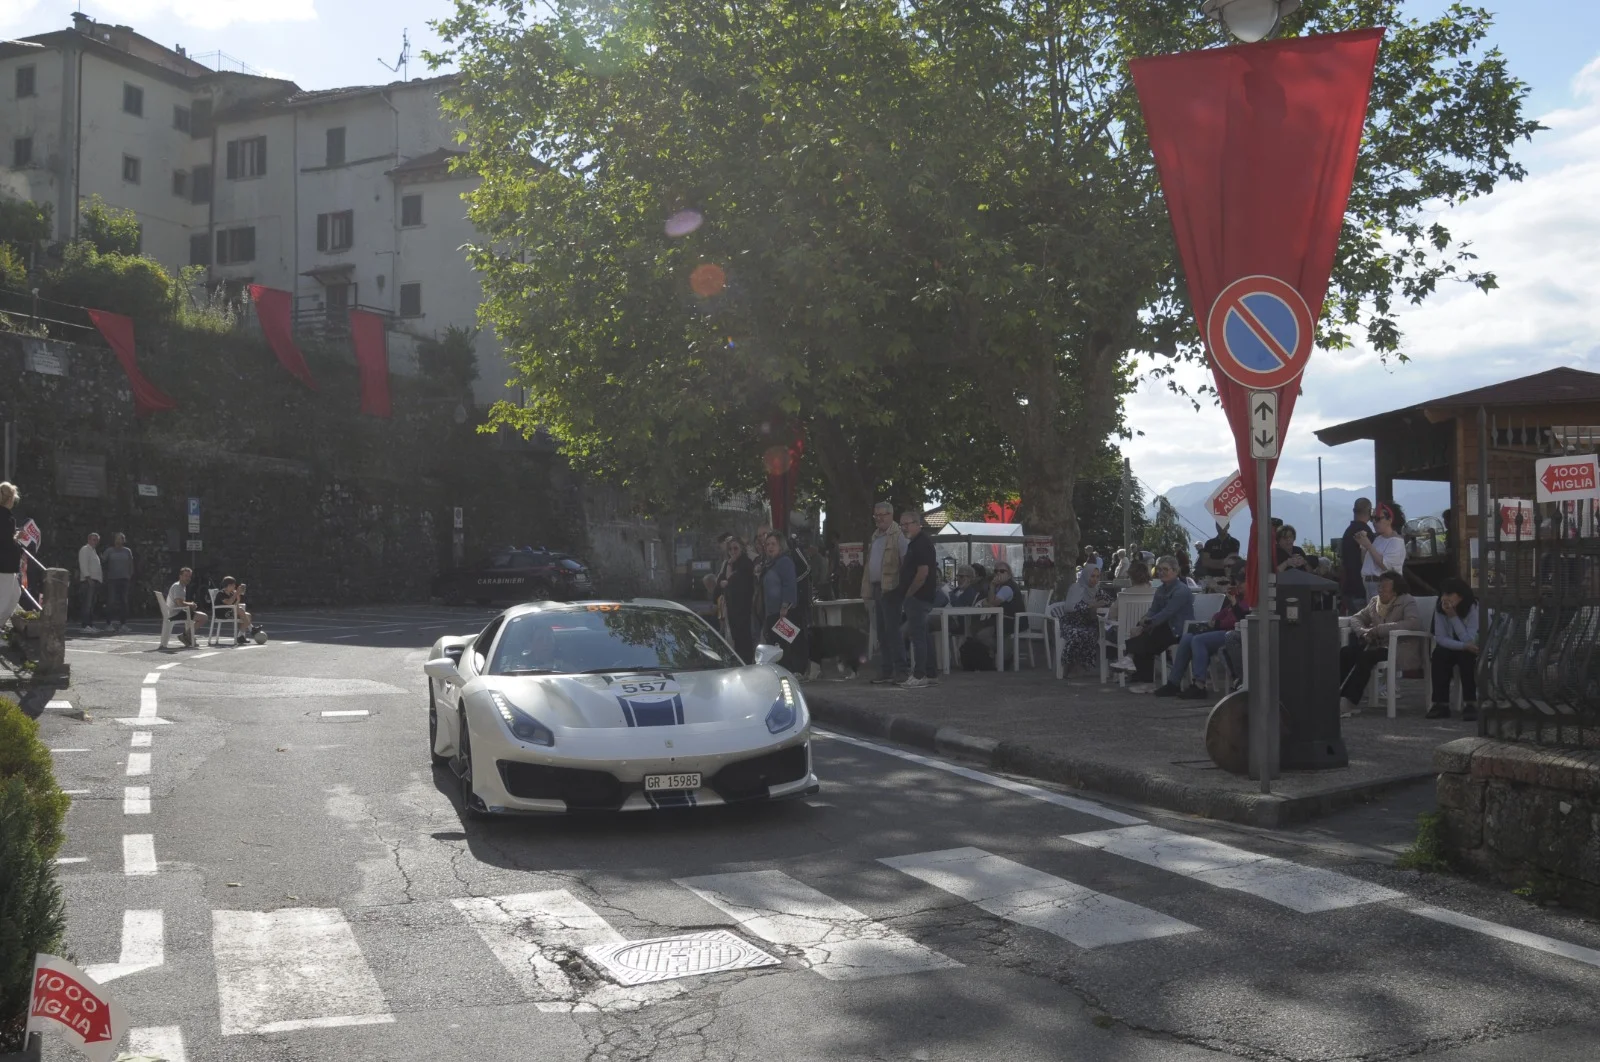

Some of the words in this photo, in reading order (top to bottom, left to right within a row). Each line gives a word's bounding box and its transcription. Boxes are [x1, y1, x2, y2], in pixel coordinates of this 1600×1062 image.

[1554, 466, 1589, 477] 1000
[1553, 478, 1593, 490] MIGLIA
[1219, 480, 1242, 503] 1000
[477, 577, 525, 585] CARABINIERI
[621, 681, 667, 694] 557
[647, 776, 660, 788] GR
[667, 775, 699, 788] 15985
[38, 973, 97, 1013] 1000
